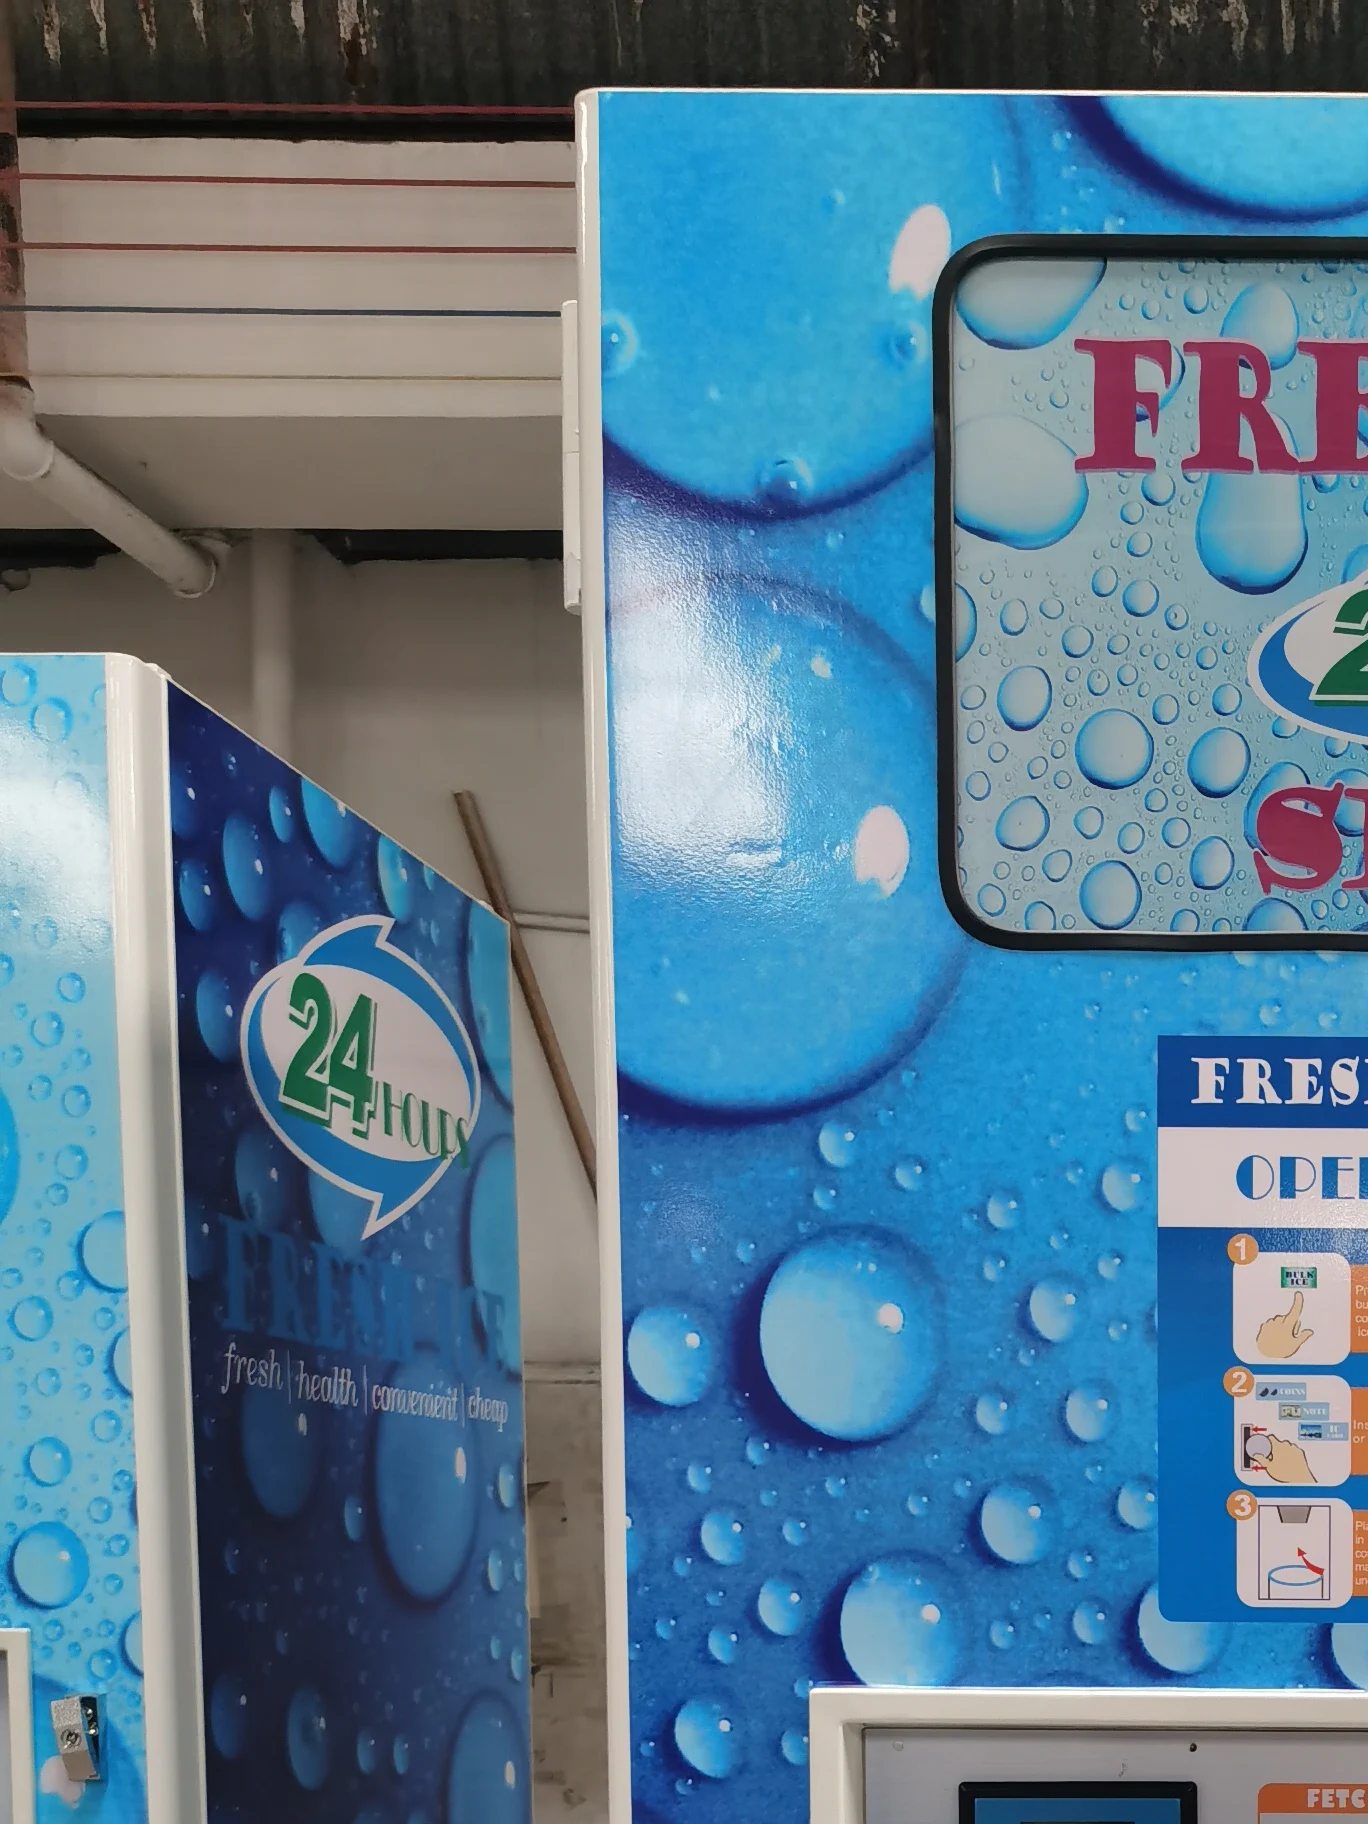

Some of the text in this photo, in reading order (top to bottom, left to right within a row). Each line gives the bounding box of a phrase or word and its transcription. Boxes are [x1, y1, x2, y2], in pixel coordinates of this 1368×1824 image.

[279, 972, 378, 1140] 24
[1233, 1237, 1247, 1261] 1
[1290, 1278, 1309, 1286] ICE
[221, 1342, 283, 1394] fresh
[297, 1360, 359, 1407] health
[467, 1387, 508, 1432] cheap
[1231, 1372, 1247, 1393] 2
[1353, 1436, 1365, 1444] or
[1234, 1494, 1251, 1516] 3
